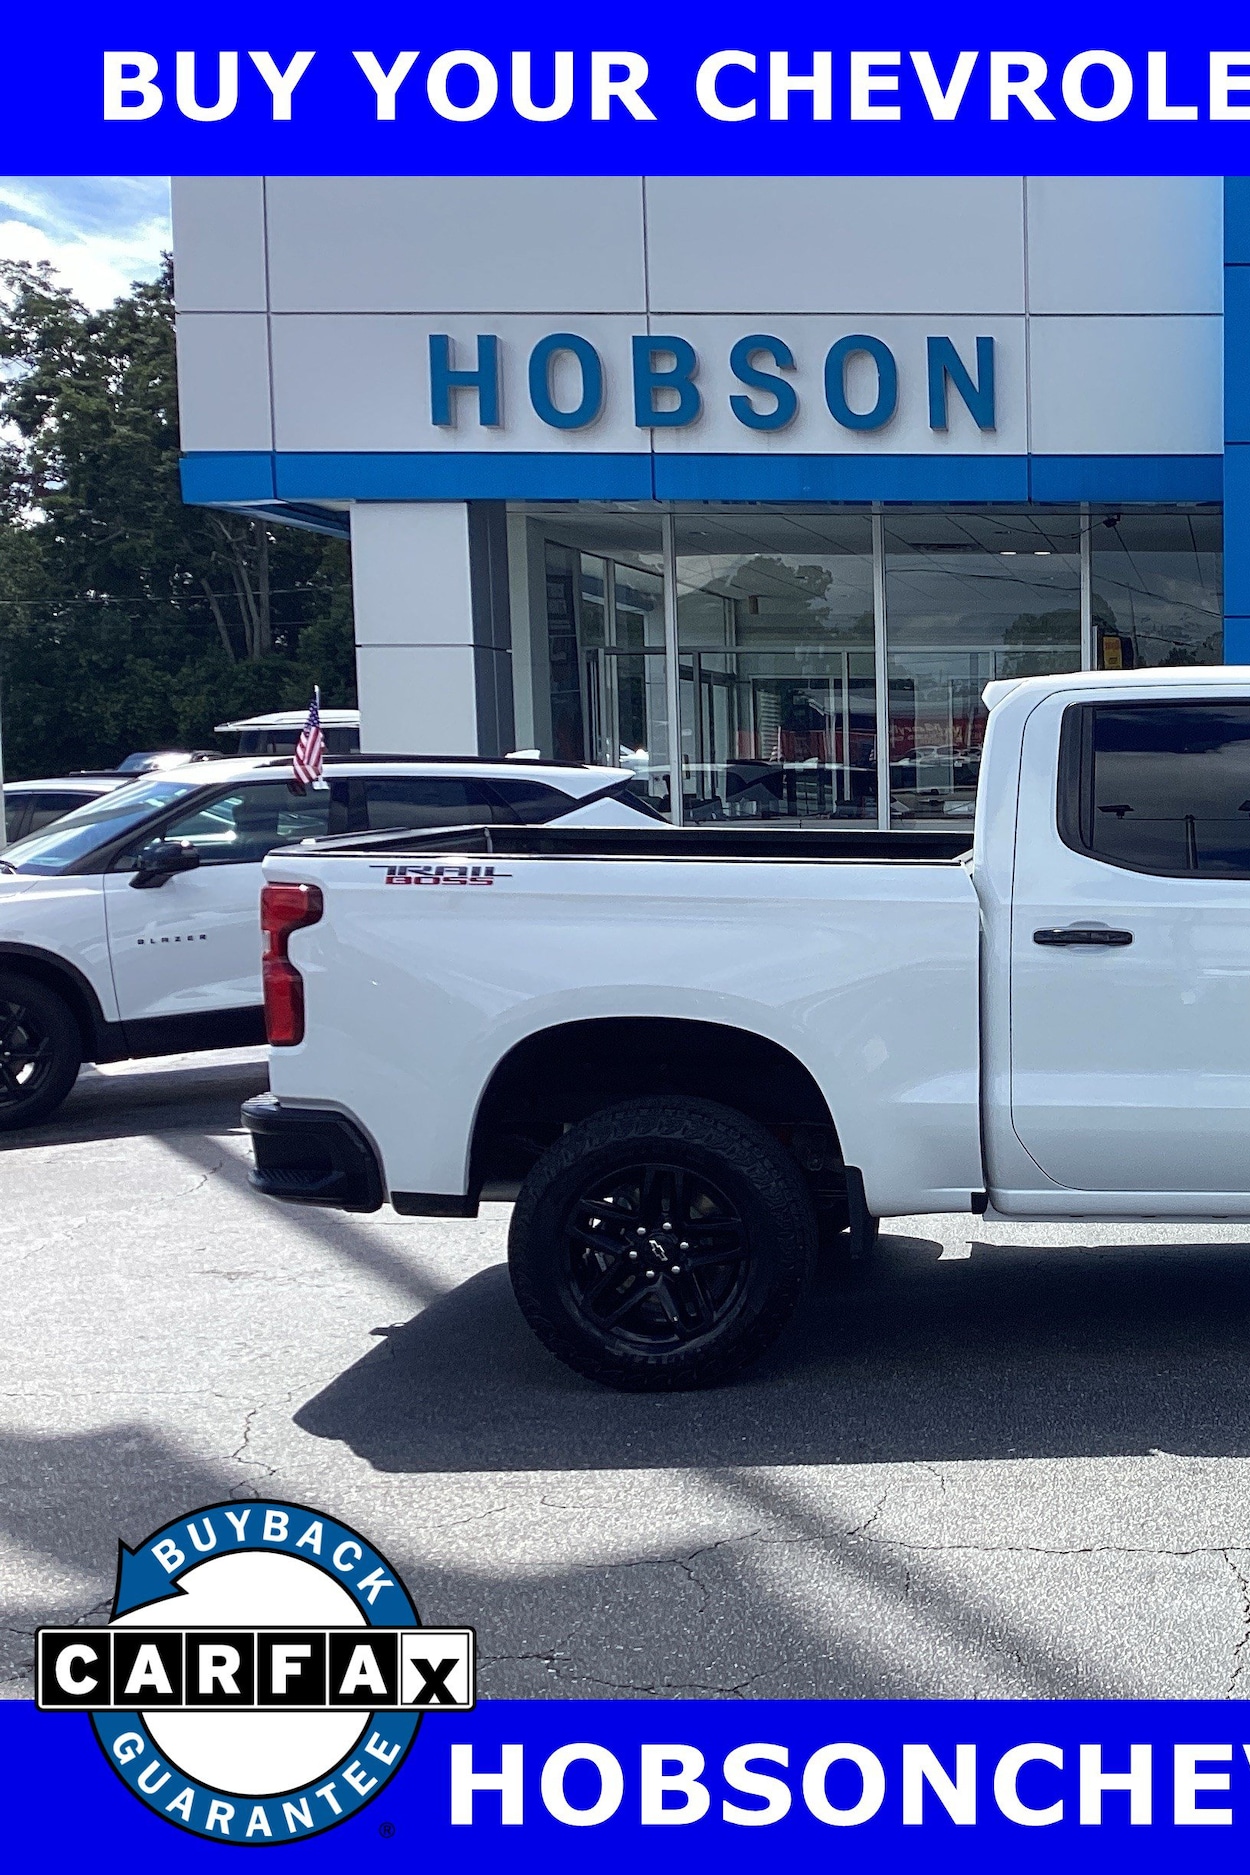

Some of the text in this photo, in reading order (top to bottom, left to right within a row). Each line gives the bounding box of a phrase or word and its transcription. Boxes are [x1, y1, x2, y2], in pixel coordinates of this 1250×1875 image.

[428, 332, 998, 432] HOBSON
[369, 865, 513, 877] TRAIL
[385, 876, 494, 886] BOSS
[137, 934, 207, 945] BLAZER
